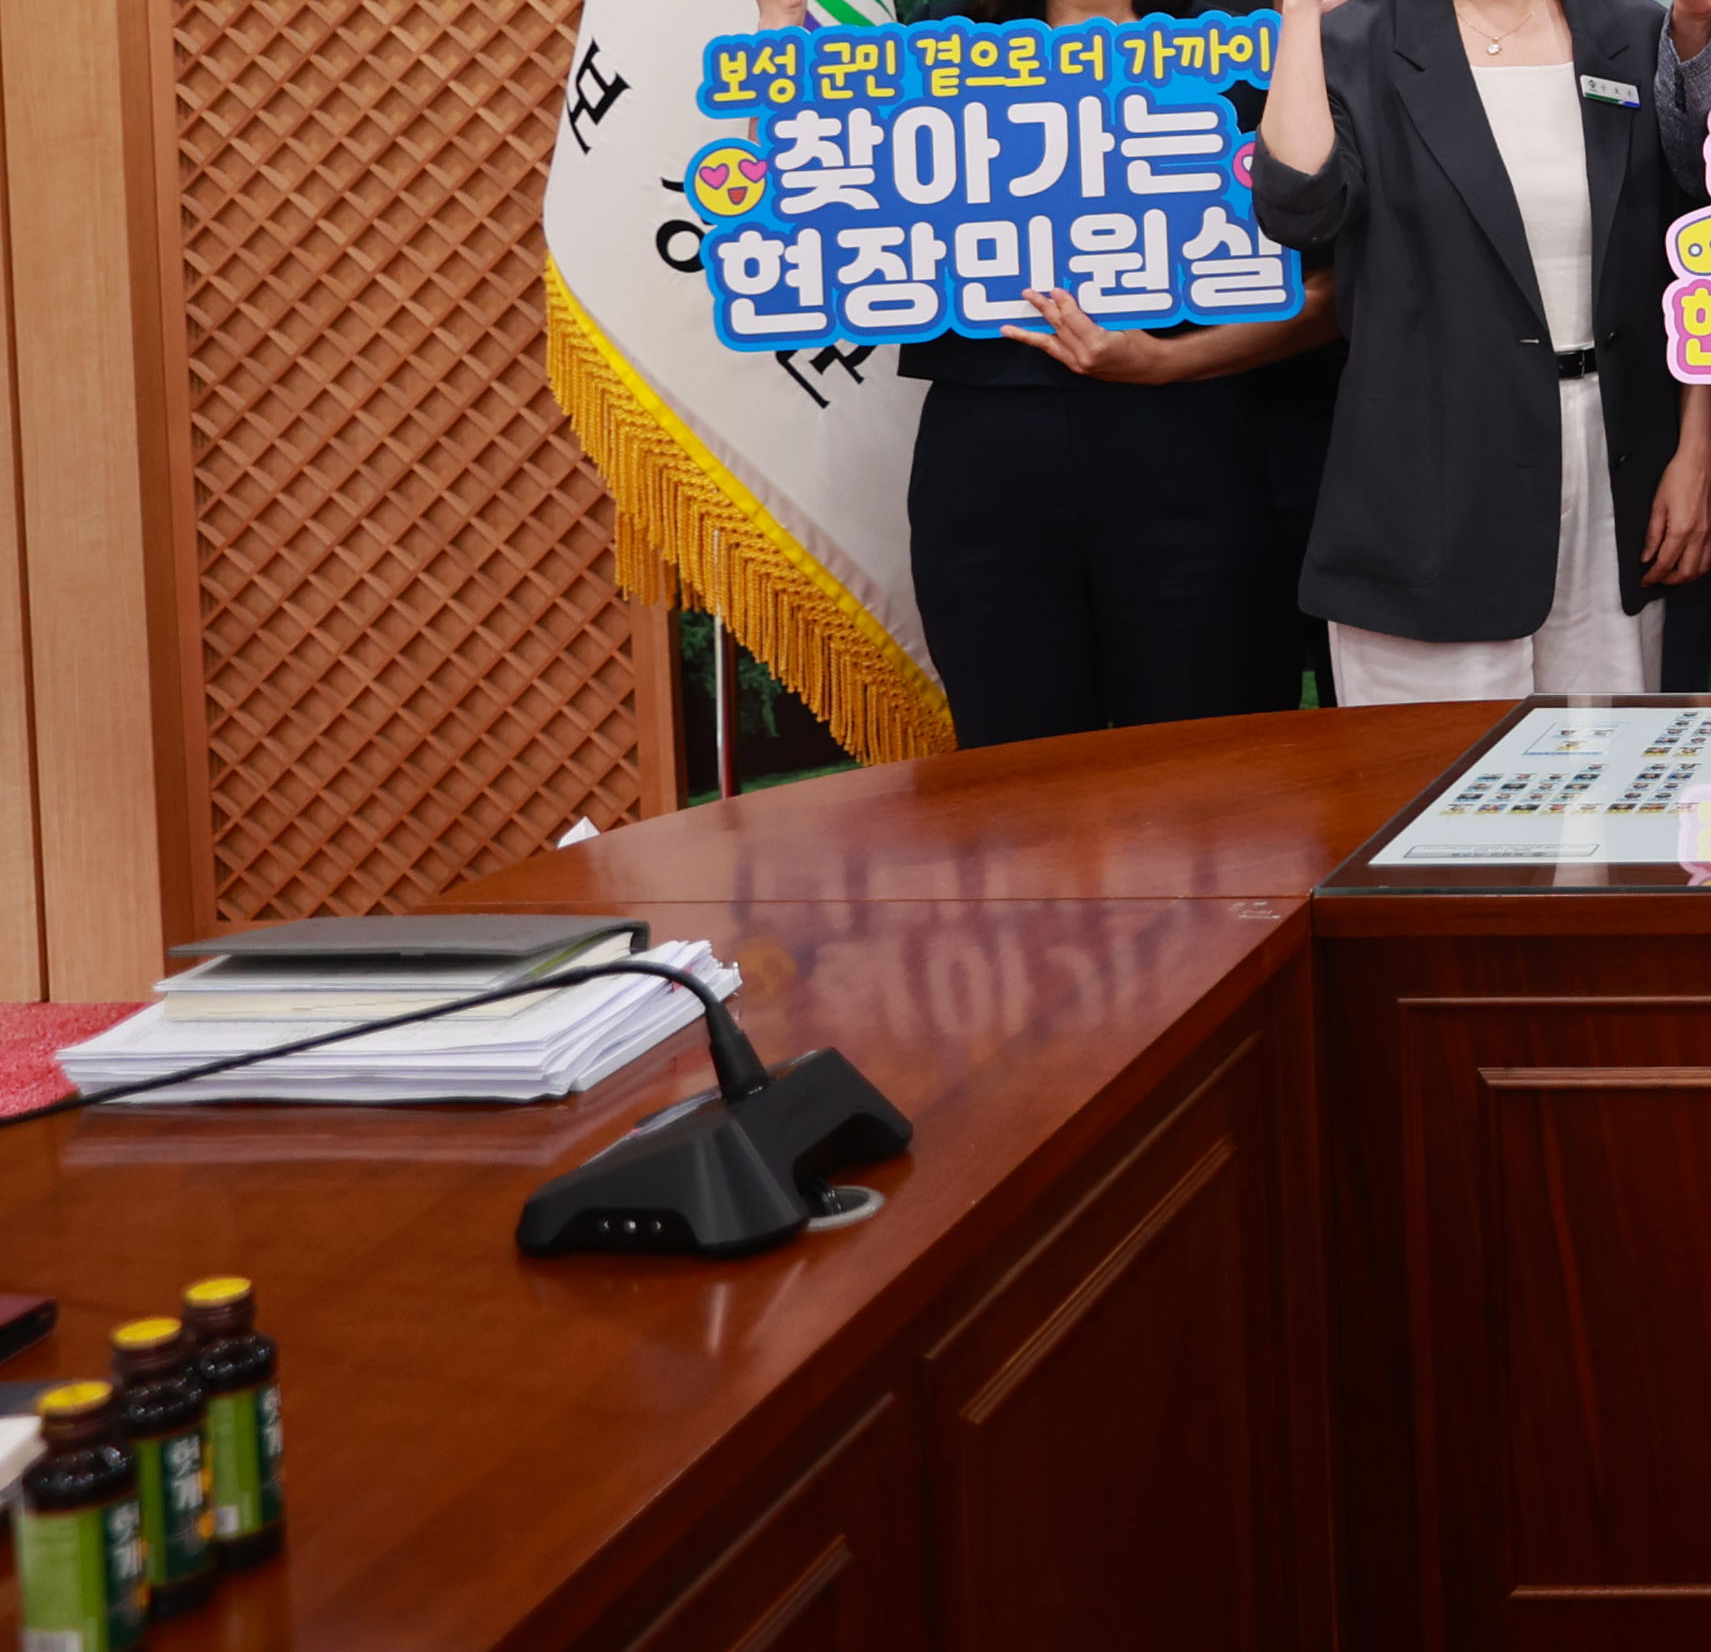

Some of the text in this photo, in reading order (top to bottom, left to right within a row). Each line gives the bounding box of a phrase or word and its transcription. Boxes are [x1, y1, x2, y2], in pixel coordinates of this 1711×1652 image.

[714, 26, 1271, 103] 보성 군민 곁으로 더 가까이
[774, 94, 1224, 215] 찾아가는
[717, 206, 1288, 336] 현장민원실
